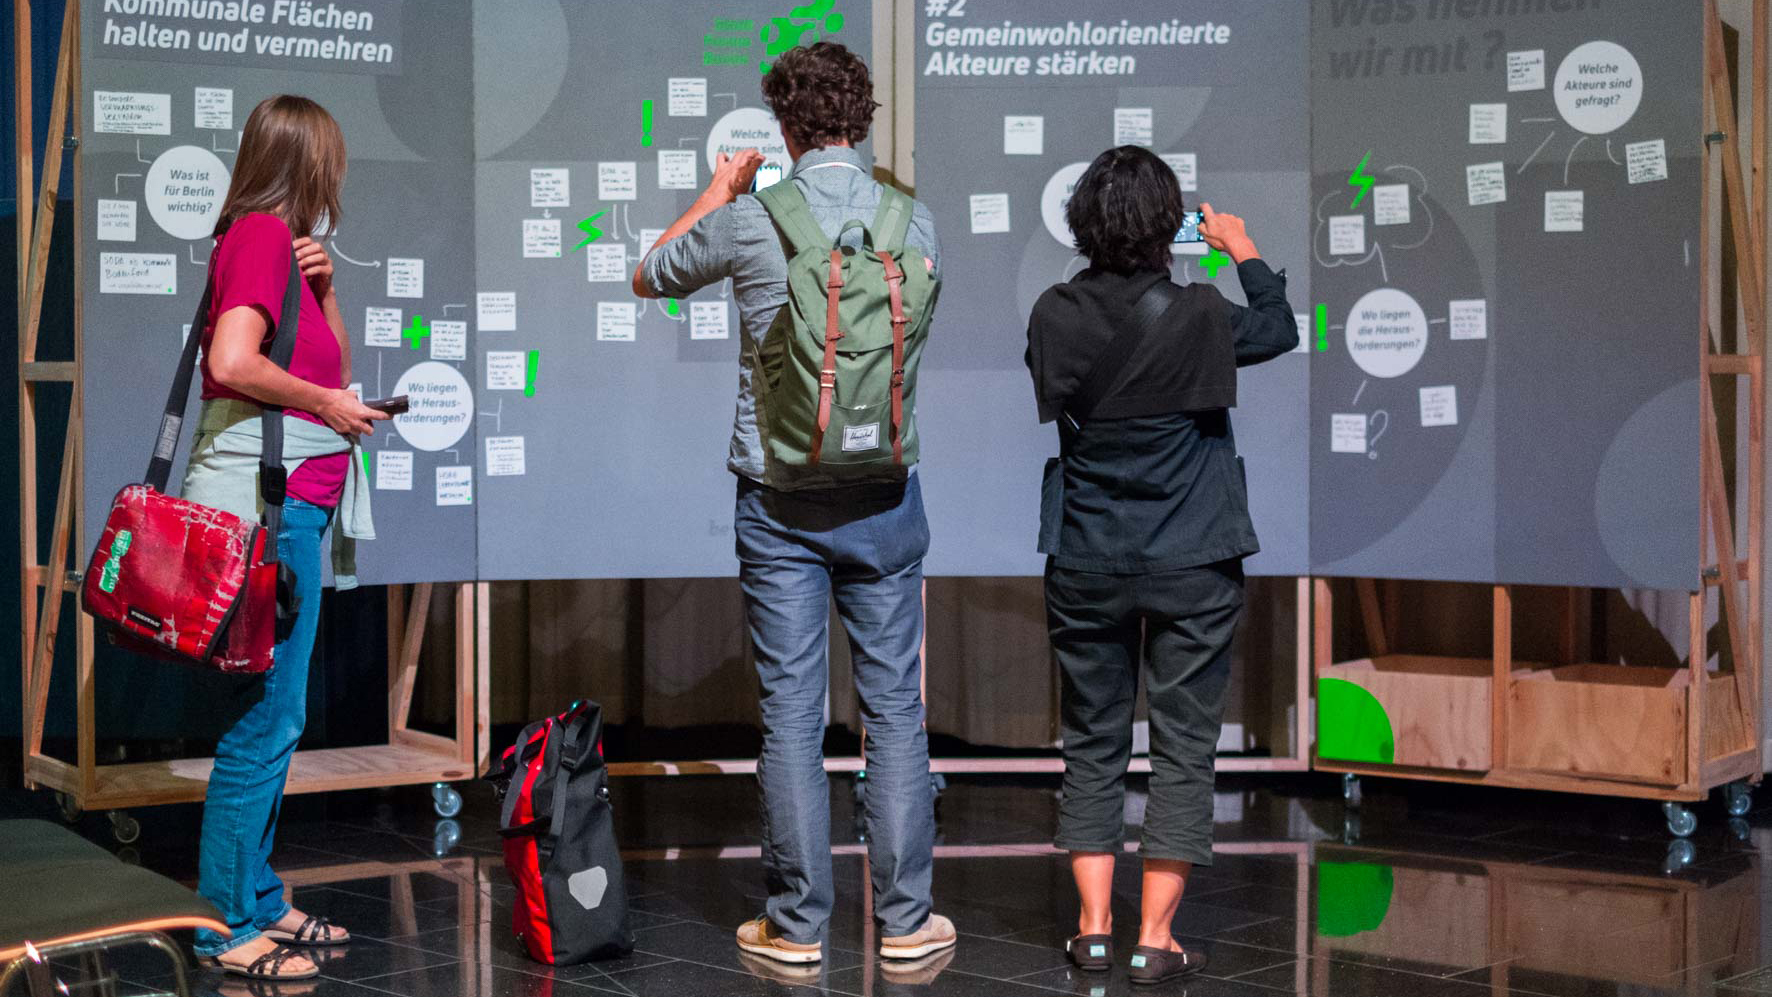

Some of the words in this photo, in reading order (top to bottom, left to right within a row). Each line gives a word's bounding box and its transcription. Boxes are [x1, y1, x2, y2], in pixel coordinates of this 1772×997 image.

[925, 0, 966, 17] #2
[271, 0, 374, 32] Flächen
[925, 19, 1231, 46] Gemeinwohlorientierte
[104, 19, 191, 50] halten
[197, 28, 250, 54] und
[254, 35, 393, 63] vermehren
[924, 51, 1031, 76] Akteure
[1035, 49, 1136, 75] stärken
[1578, 63, 1619, 75] Welche
[1563, 80, 1607, 91] Akteure
[1608, 78, 1633, 89] sind
[1575, 94, 1621, 108] gefragt?
[731, 129, 771, 140] Welche
[762, 143, 785, 154] sind
[170, 169, 194, 182] Was
[196, 169, 209, 182] ist
[164, 184, 180, 197] für
[183, 185, 214, 198] Berlin
[168, 201, 213, 216] wichtig?
[1361, 310, 1378, 321] Wo
[1380, 309, 1411, 322] liegen
[1353, 338, 1420, 352] forderungen?
[408, 382, 425, 393] Wo
[427, 382, 458, 396] liegen
[422, 398, 462, 409] Heraus-
[398, 411, 467, 425] forderungen?
